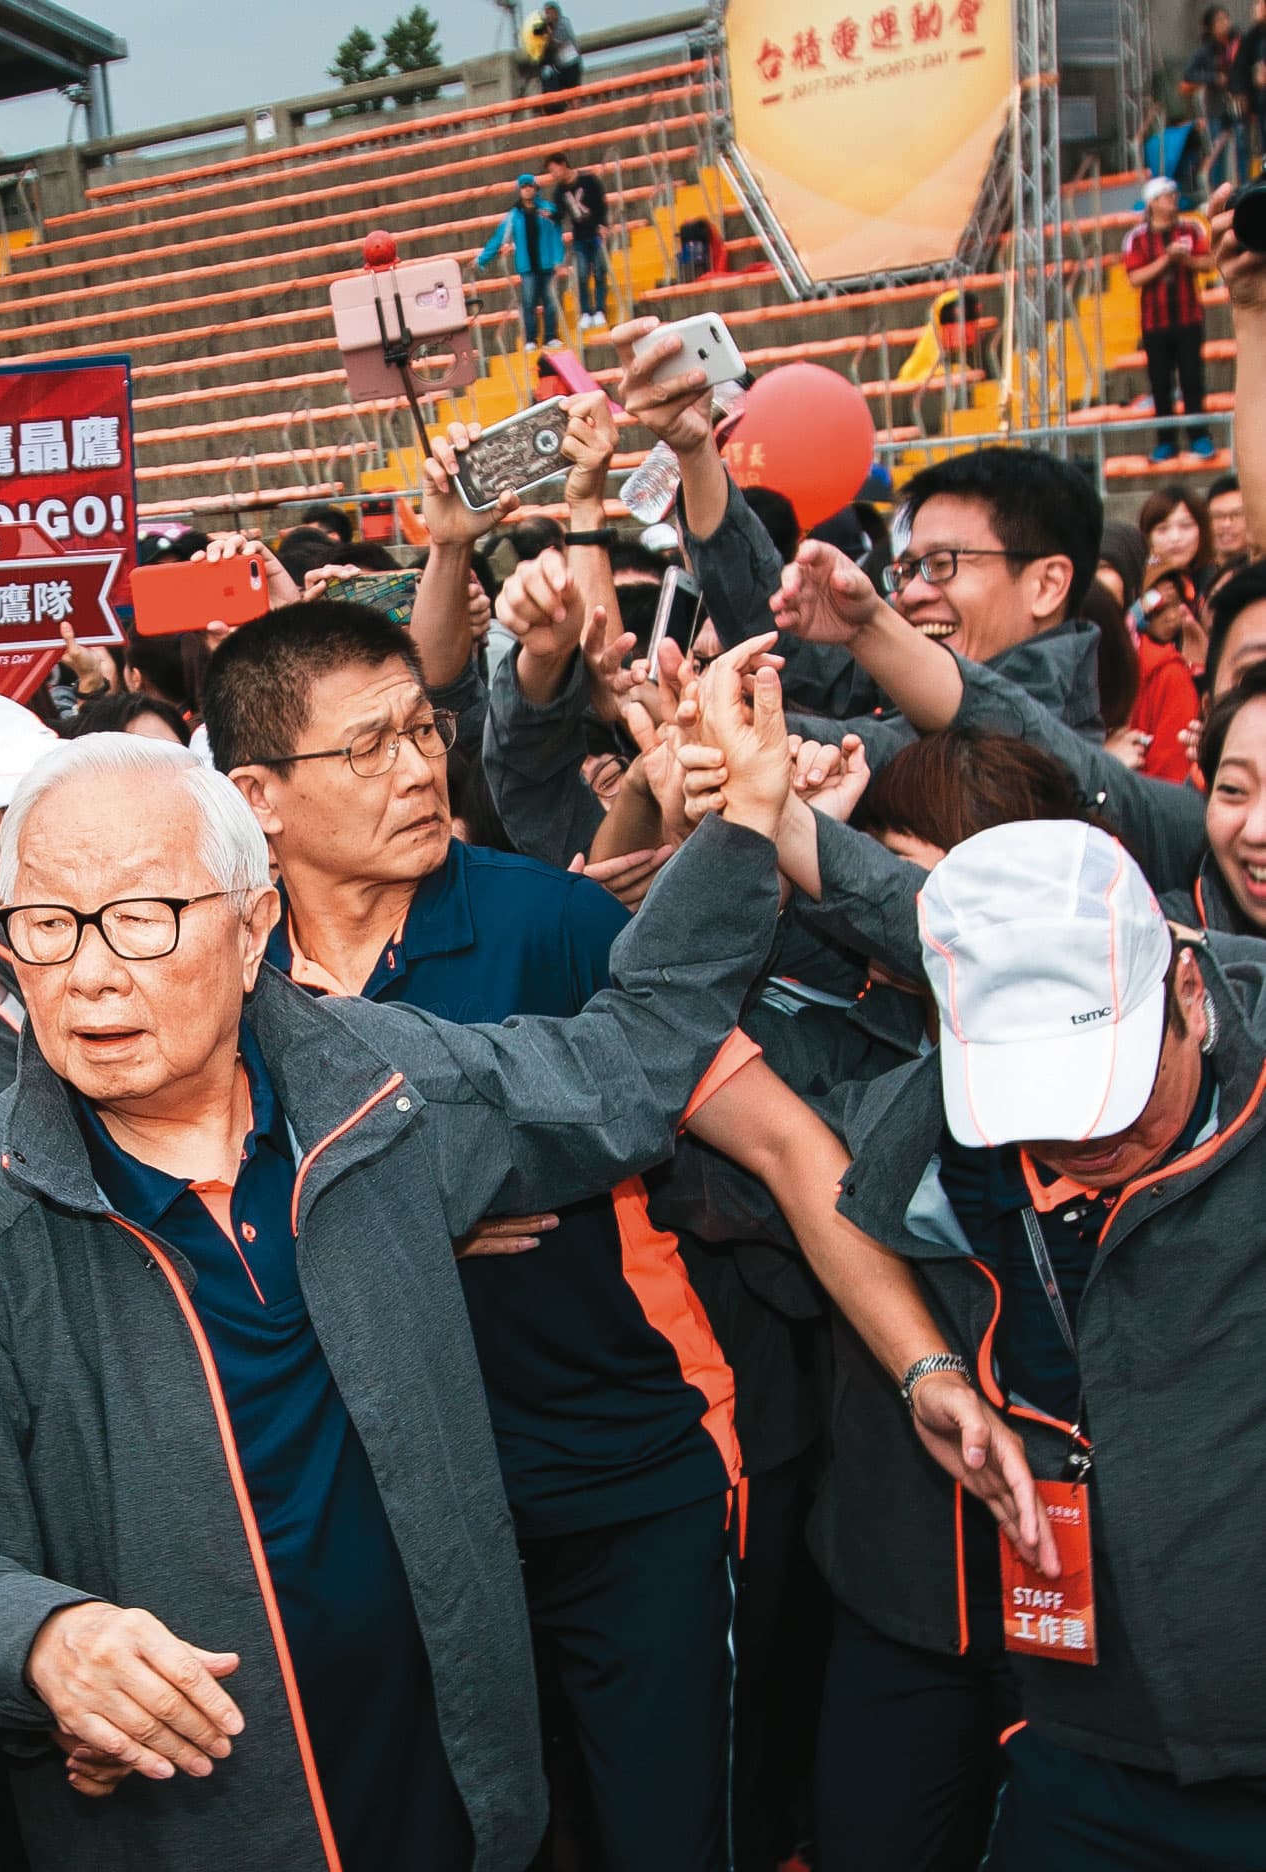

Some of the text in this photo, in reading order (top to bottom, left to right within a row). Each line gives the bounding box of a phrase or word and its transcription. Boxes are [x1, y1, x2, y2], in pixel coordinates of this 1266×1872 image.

[13, 653, 35, 664] DAY
[1071, 1006, 1112, 1025] tsmc
[1013, 1586, 1064, 1610] STAFF
